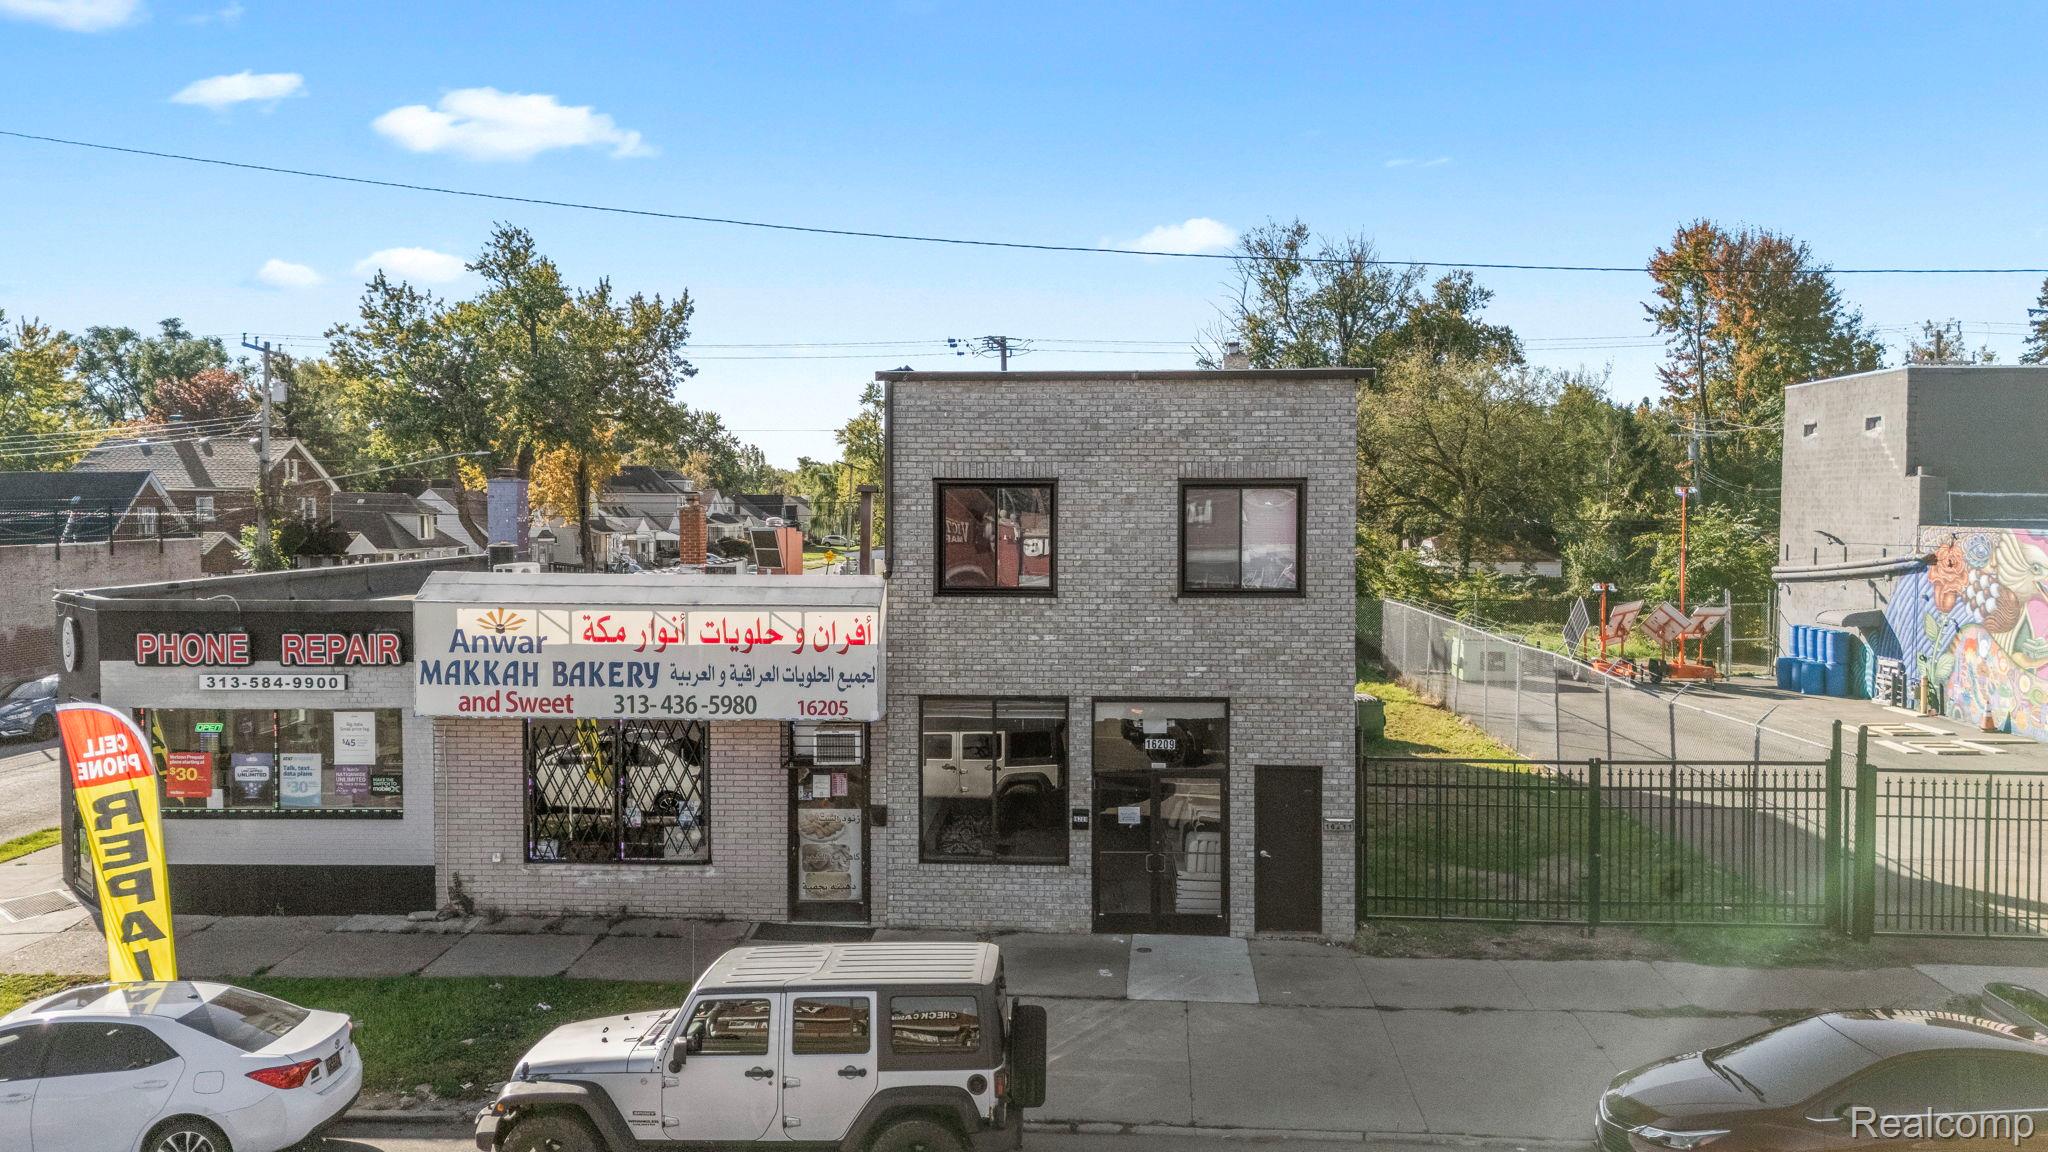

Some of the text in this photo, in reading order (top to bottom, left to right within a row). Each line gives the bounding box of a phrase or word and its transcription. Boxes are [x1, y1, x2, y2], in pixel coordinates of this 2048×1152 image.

[449, 628, 548, 654] Anwar
[582, 612, 872, 654] أفران و حلويات أنوار مكة
[136, 633, 401, 665] PHONE REPAIR
[206, 677, 338, 689] 313-584-9900
[419, 659, 660, 689] MAKKAH BAKERY
[670, 662, 876, 691] لجميع الحلويات العراقية و العربية
[458, 690, 574, 714] and Sweet
[797, 700, 849, 716] 16205
[195, 724, 221, 732] OPEN
[342, 738, 356, 747] $45
[1146, 740, 1175, 749] 16209
[169, 766, 198, 781] $30
